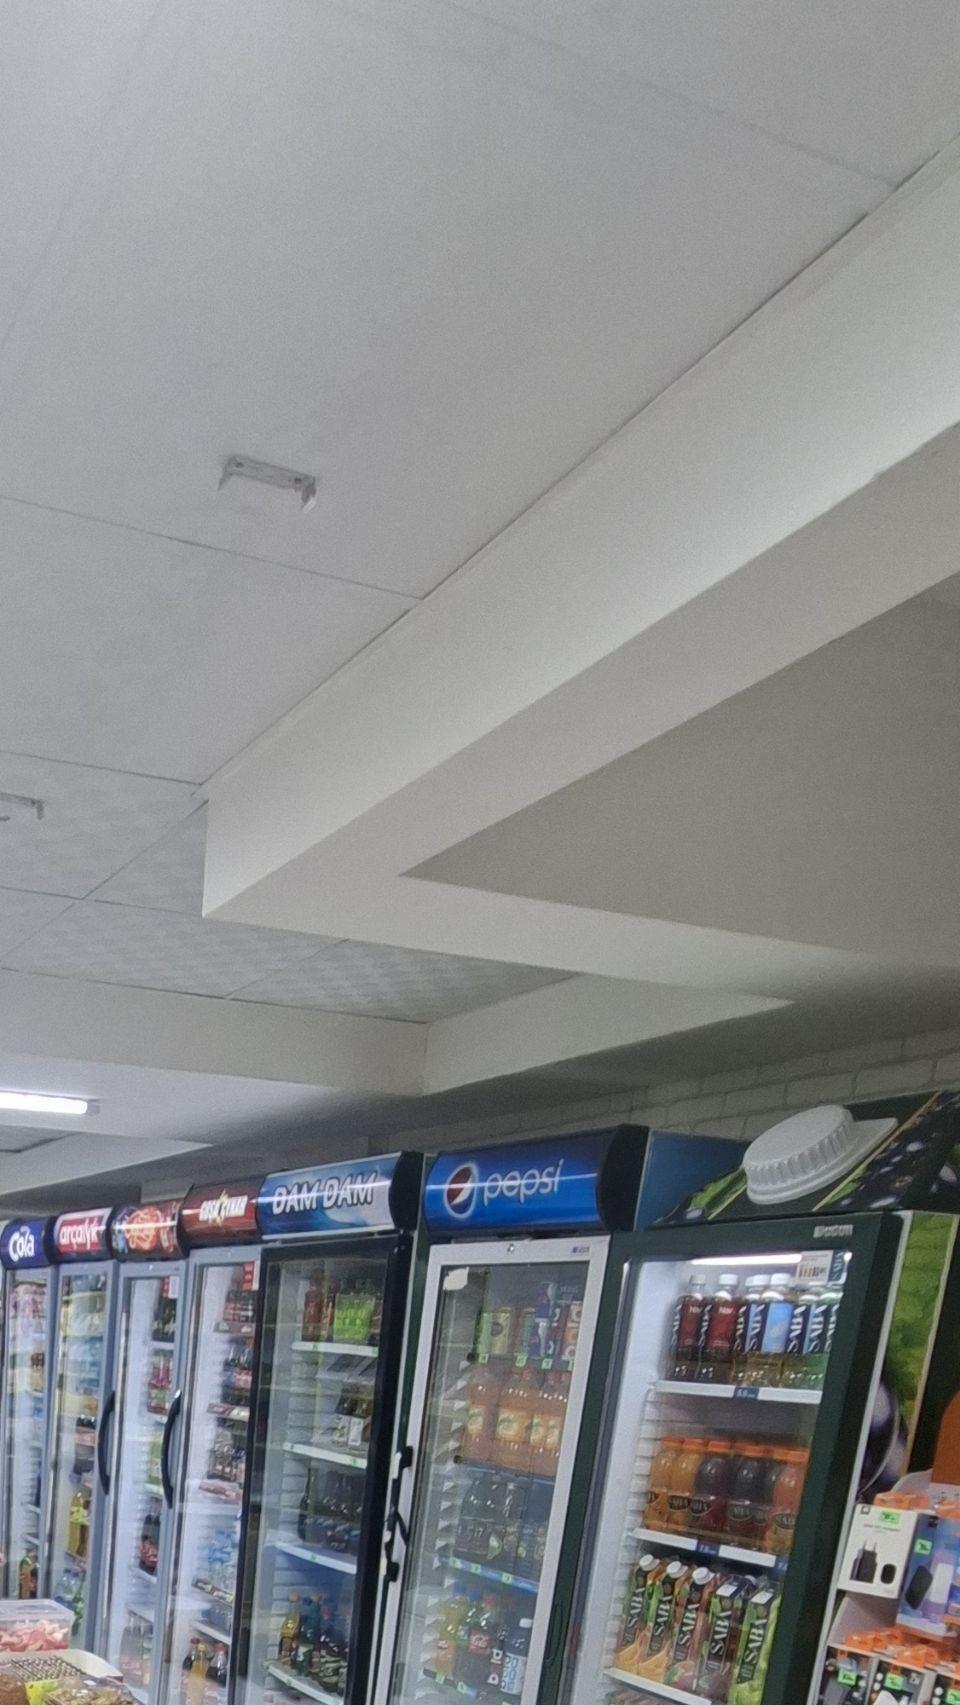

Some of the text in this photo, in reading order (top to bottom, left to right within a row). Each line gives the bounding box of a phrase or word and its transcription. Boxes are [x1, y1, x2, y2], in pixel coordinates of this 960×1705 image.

[271, 1172, 378, 1215] DAM DAM
[483, 1158, 565, 1207] pepsi
[628, 1587, 645, 1629] SABA
[654, 1595, 672, 1637] SABA
[679, 1603, 700, 1646] SABA
[711, 1610, 731, 1656] SABA
[745, 1618, 767, 1664] SABA
